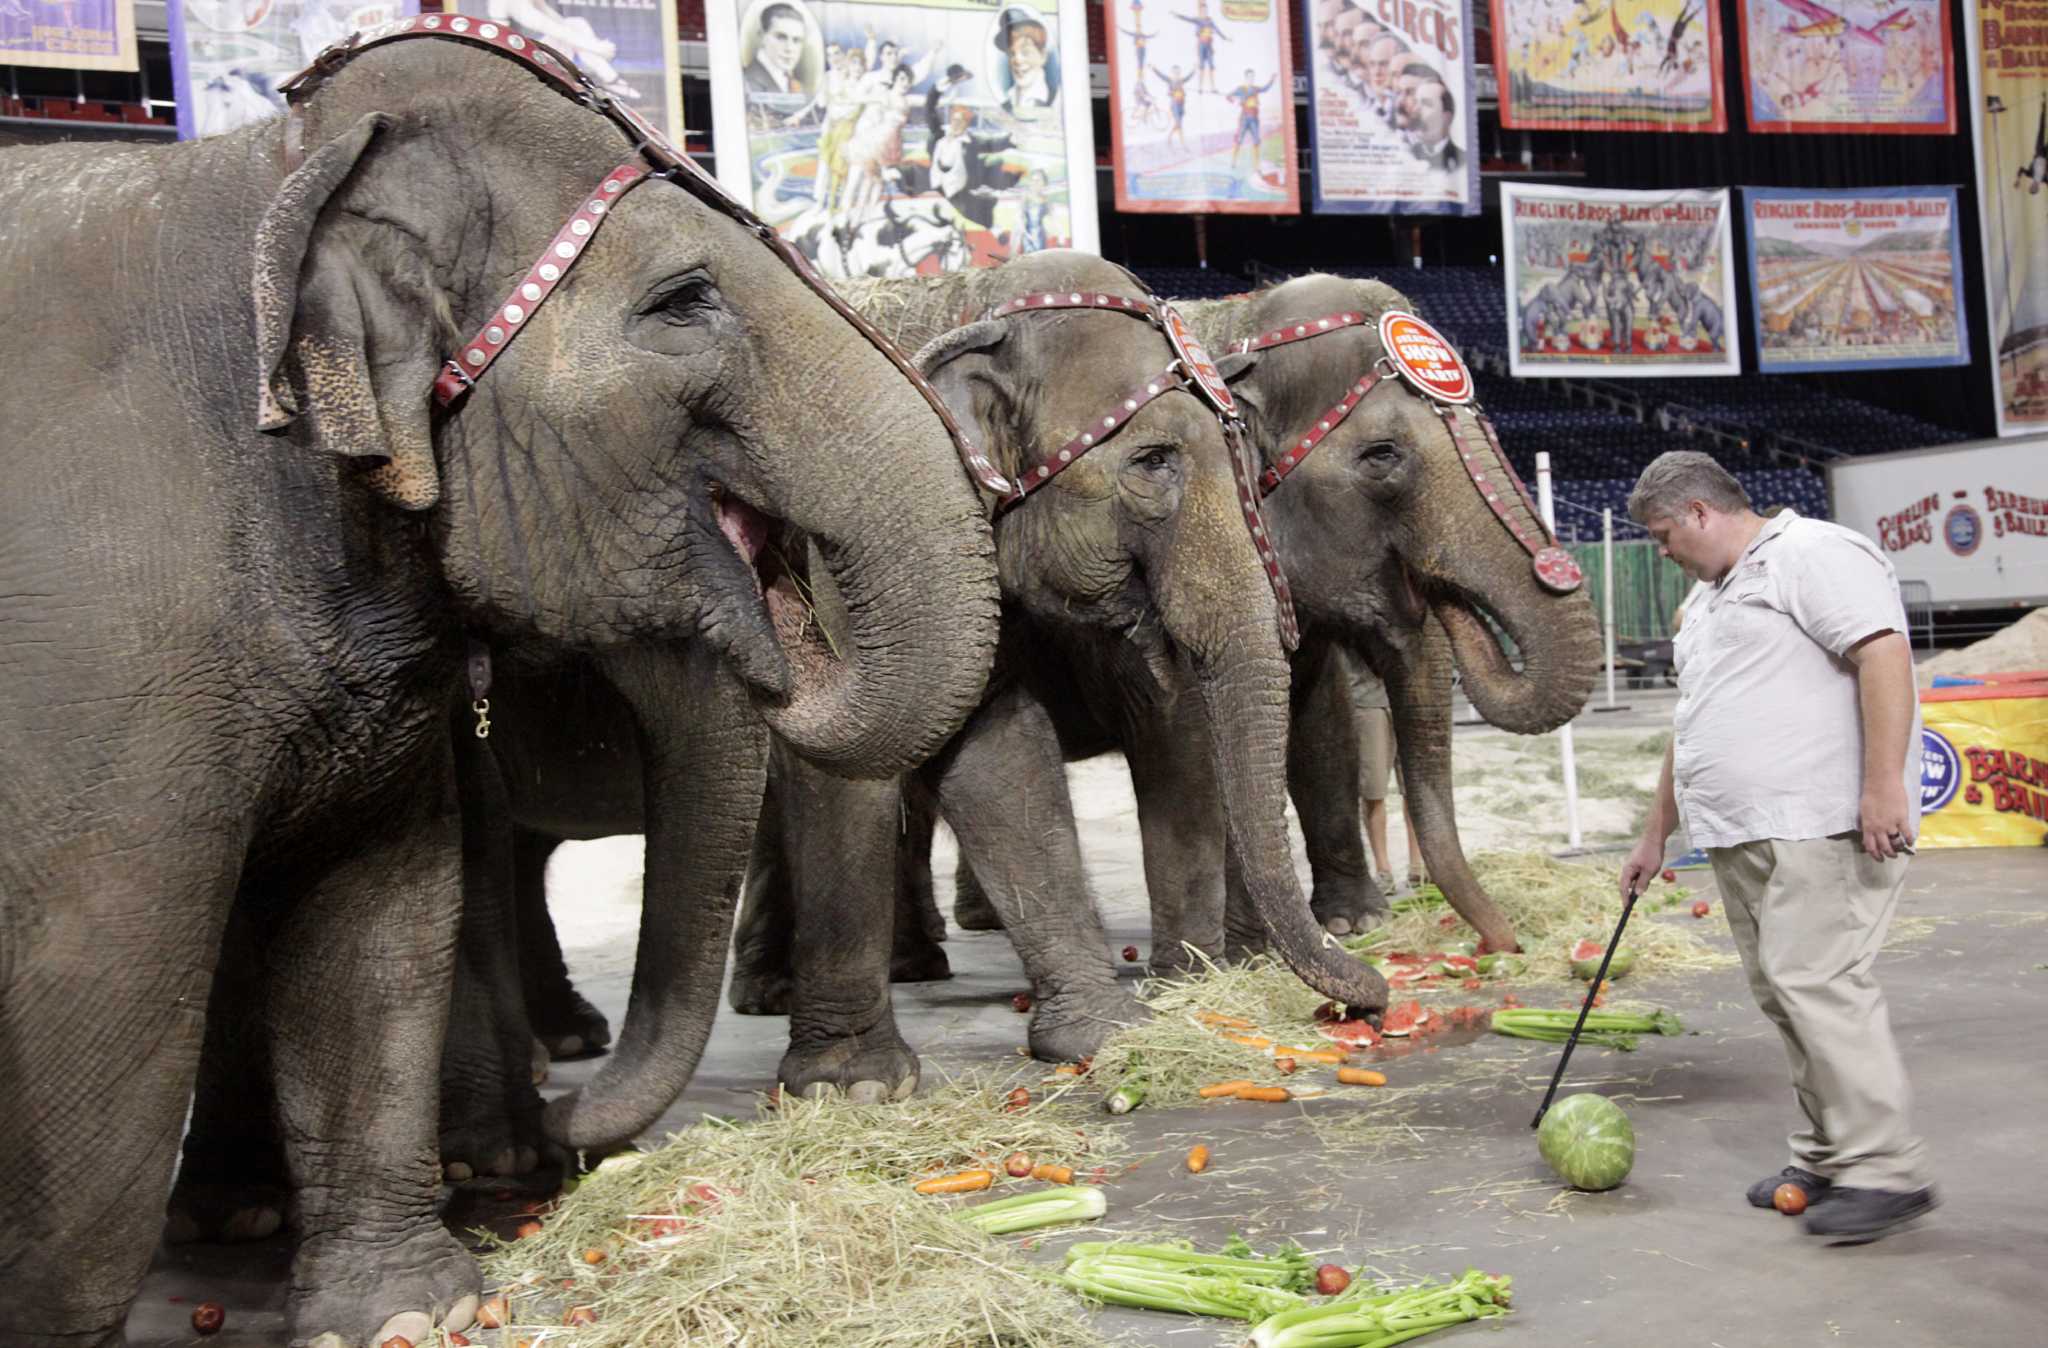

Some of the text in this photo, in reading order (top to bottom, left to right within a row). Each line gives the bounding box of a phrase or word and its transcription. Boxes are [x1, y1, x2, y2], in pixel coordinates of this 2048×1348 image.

[1515, 198, 1573, 219] RINGLING
[1578, 200, 1611, 222] BROS
[1676, 203, 1719, 221] BAILEY
[1754, 199, 1948, 219] RINGLING BROS BARNUM BAILEY
[1400, 345, 1453, 362] SHOW
[1415, 367, 1461, 381] EARTH
[1964, 783, 1982, 806] &
